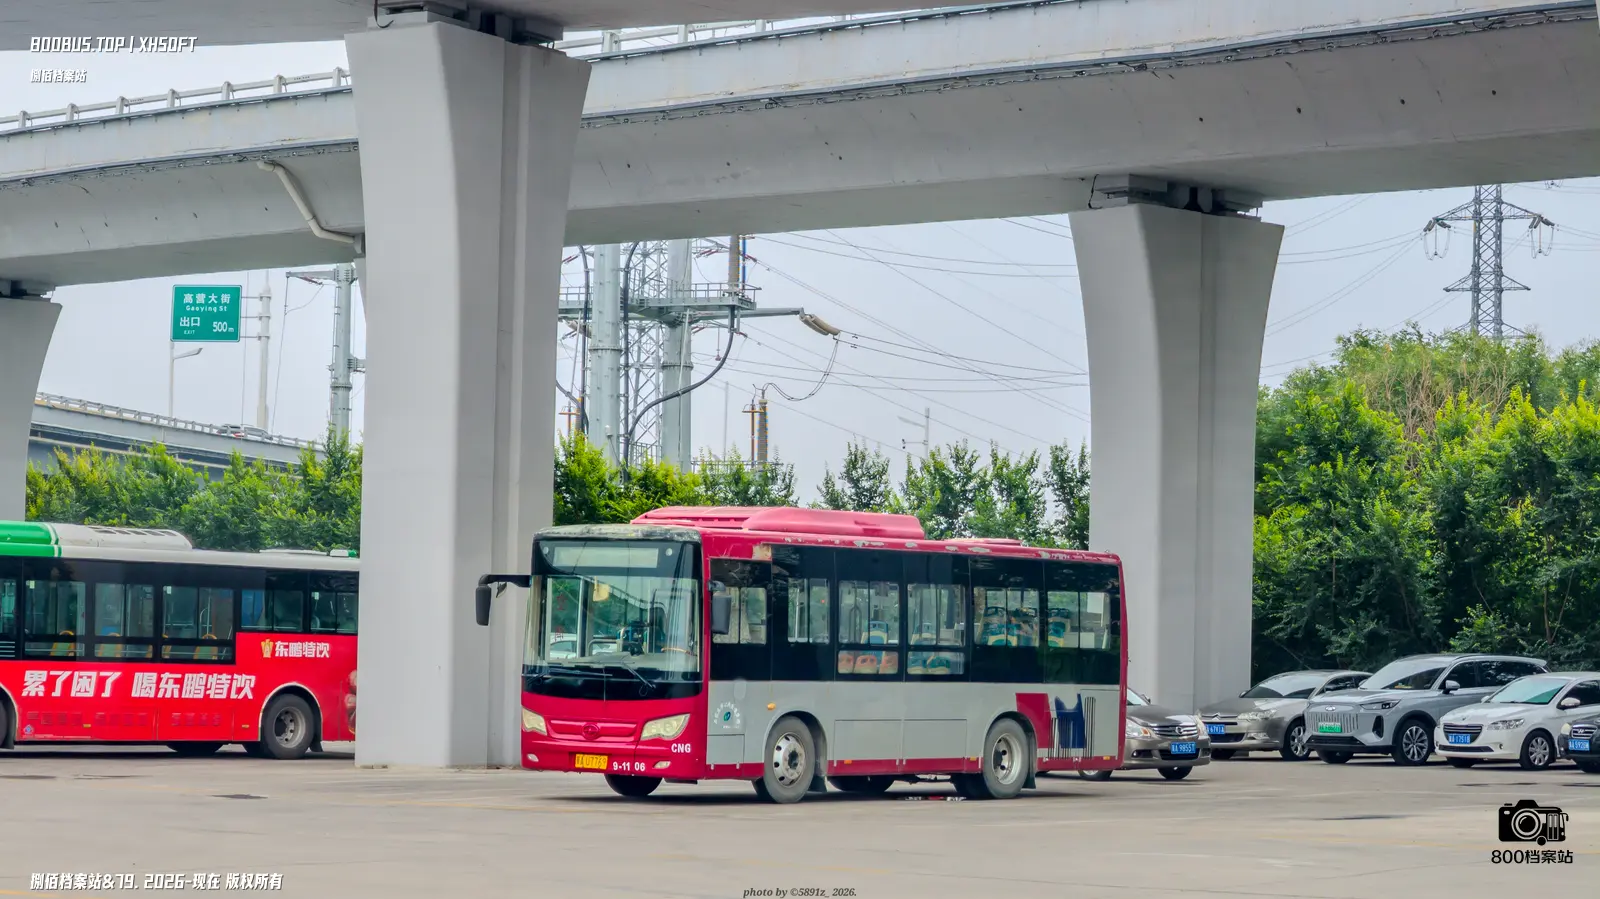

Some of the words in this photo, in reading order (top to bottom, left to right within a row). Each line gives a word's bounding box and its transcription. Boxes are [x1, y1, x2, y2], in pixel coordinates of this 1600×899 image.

[183, 293, 231, 304] 高营大街
[185, 305, 217, 313] Gaoying
[179, 316, 201, 327] 出口
[275, 641, 330, 659] 东鹏特饮
[21, 670, 122, 698] 累了困了
[131, 672, 256, 700] 喝东鹏特饮
[671, 743, 691, 753] CNG
[613, 761, 631, 771] 9-11
[634, 762, 646, 771] 06
